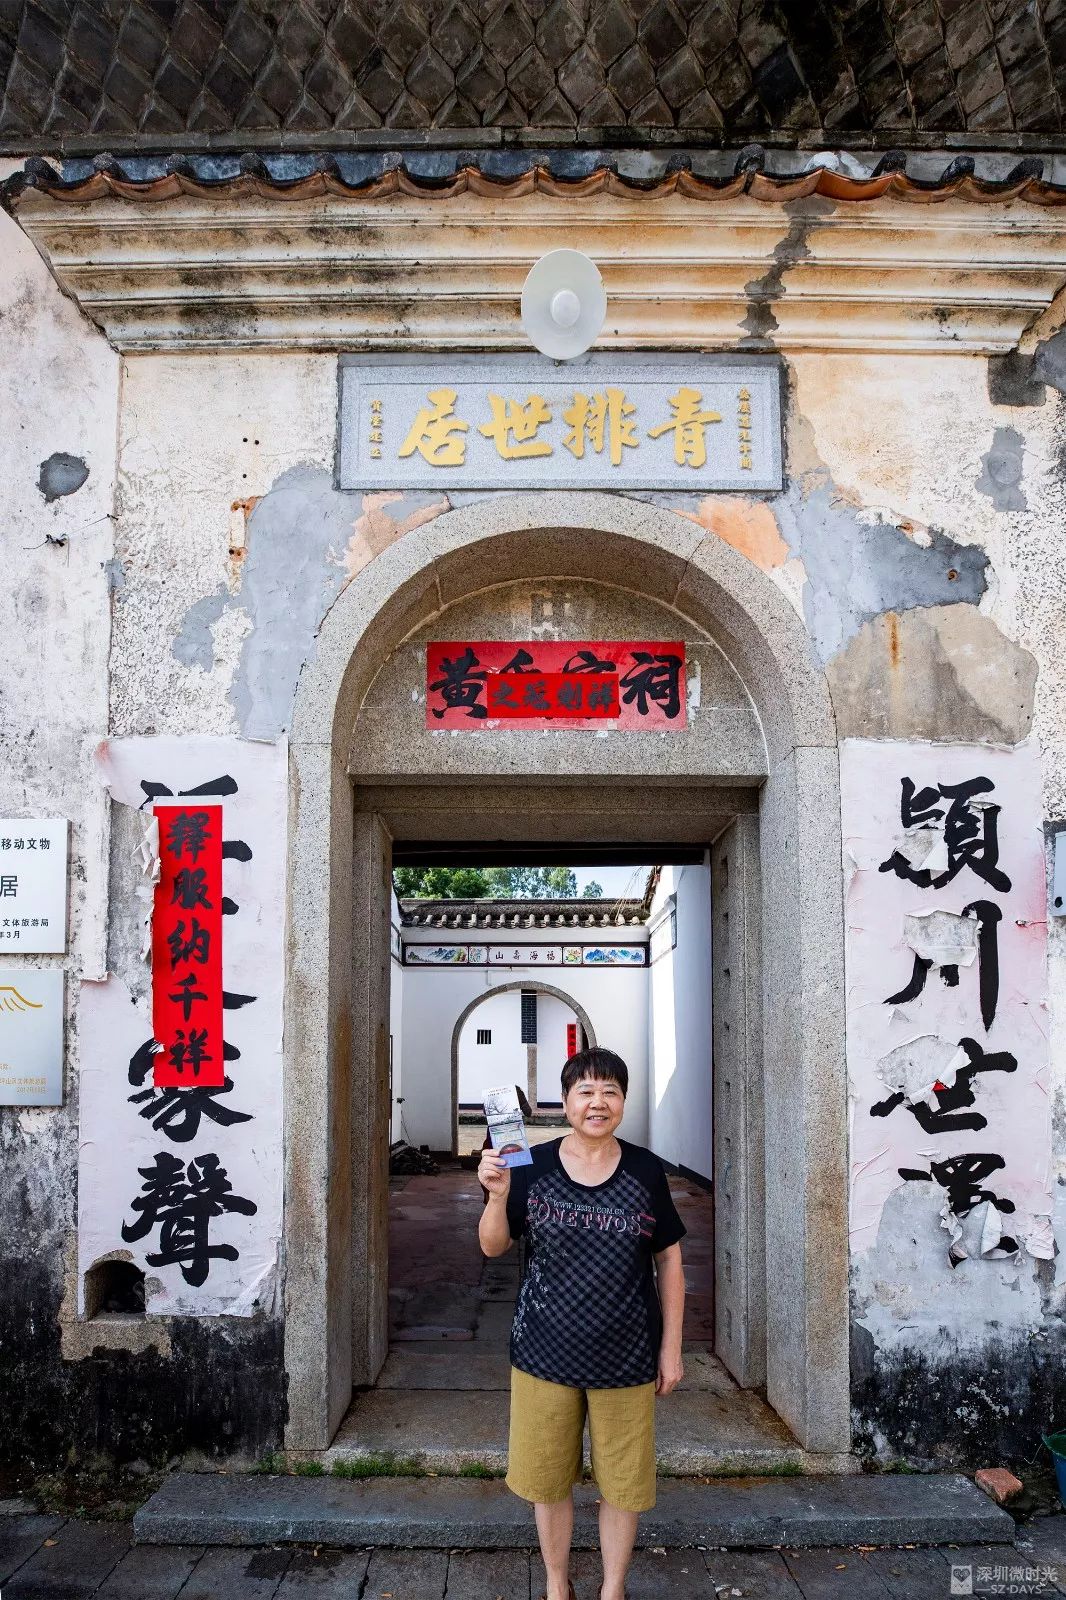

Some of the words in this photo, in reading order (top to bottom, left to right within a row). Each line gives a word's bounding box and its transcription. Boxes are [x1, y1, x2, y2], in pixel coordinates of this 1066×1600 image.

[1, 838, 51, 850] 移动文物
[0, 875, 19, 898] 居
